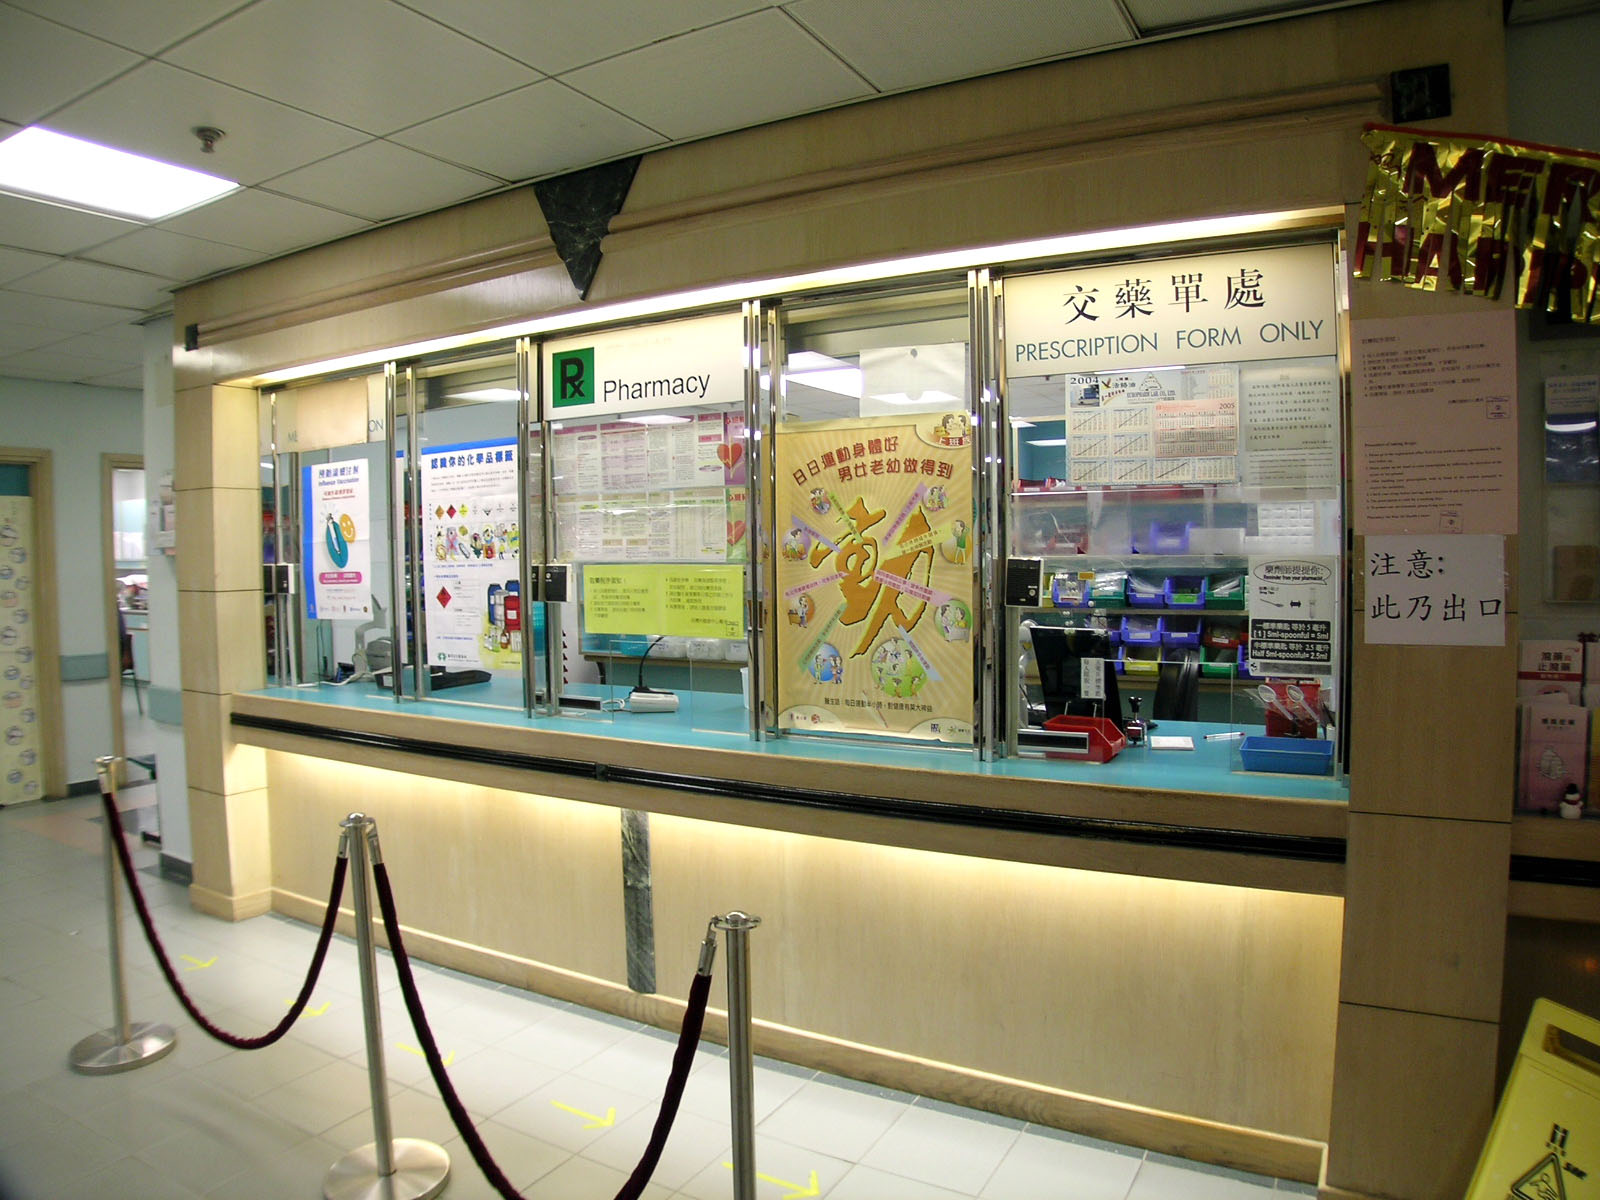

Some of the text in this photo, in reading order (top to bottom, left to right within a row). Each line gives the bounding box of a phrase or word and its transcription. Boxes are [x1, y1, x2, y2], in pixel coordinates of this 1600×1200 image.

[1063, 268, 1266, 325] 交藥單處
[1015, 319, 1324, 362] PRESCRIPTION FORM ONLY
[603, 374, 711, 402] Pharmacy
[1070, 376, 1099, 385] 2004
[1219, 402, 1235, 410] 2005
[792, 436, 899, 486] 日日運動身體好
[838, 457, 954, 484] 男女老幼做得到
[1369, 549, 1445, 579] 注意:
[1370, 593, 1502, 622] 此乃出口
[1316, 632, 1329, 640] 5ml
[1310, 652, 1328, 660] 2.5ml
